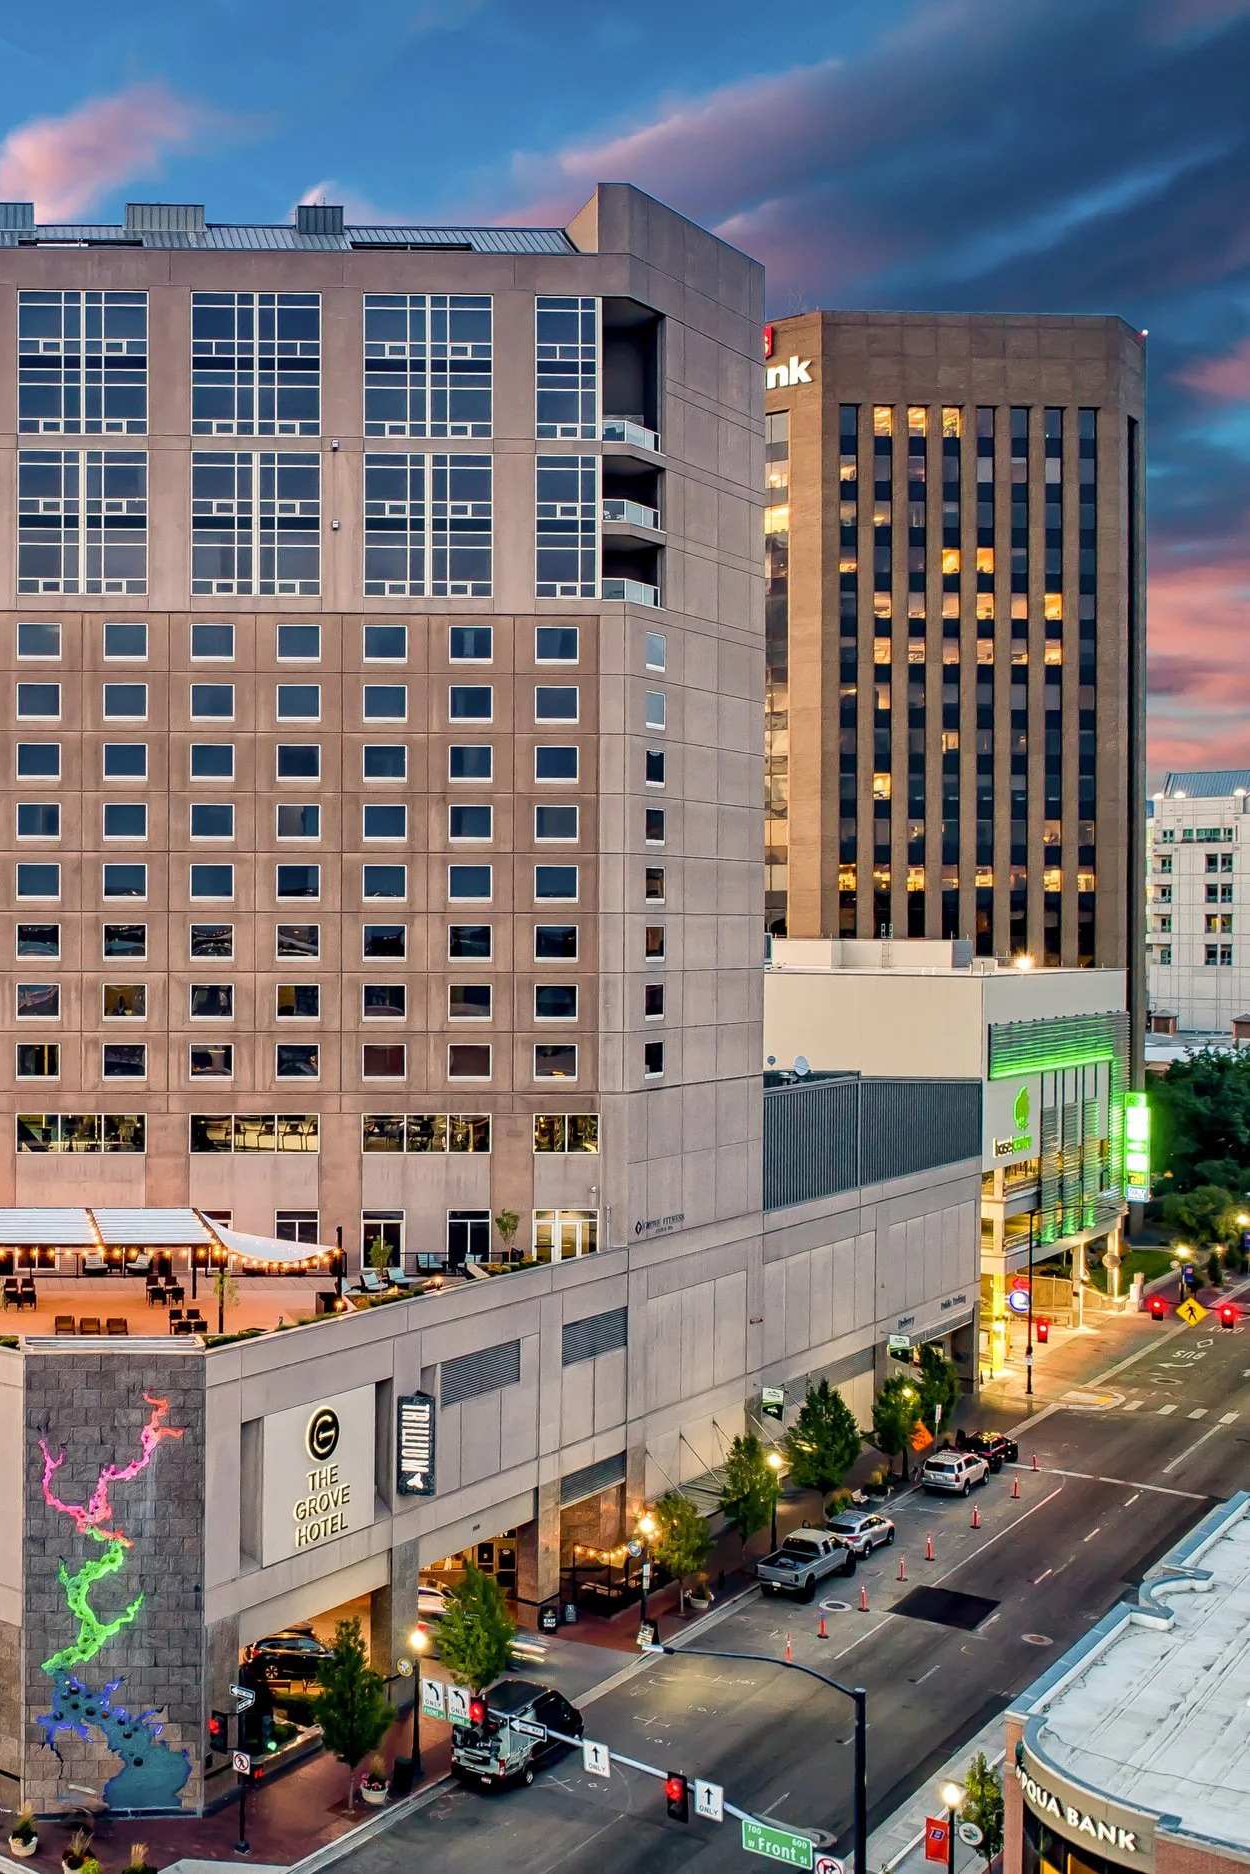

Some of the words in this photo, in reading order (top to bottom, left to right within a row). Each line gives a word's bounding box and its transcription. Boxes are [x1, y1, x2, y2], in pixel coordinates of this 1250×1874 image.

[765, 355, 813, 390] nk
[1171, 1350, 1207, 1360] BUS
[401, 1404, 430, 1473] TRILLIUM
[306, 1464, 339, 1492] THE
[293, 1484, 351, 1522] GROVE
[295, 1512, 349, 1547] HOTEL
[424, 1699, 442, 1708] ONLY
[423, 1707, 439, 1717] FRONT
[450, 1706, 468, 1716] ONLY
[449, 1715, 465, 1725] FRONT
[519, 1723, 530, 1732] ONE
[532, 1726, 542, 1734] WAY
[588, 1762, 606, 1773] ONLY
[699, 1805, 719, 1816] ONLY
[747, 1824, 762, 1835] 700
[1067, 1806, 1136, 1852] BANK
[758, 1837, 797, 1861] Front
[792, 1838, 807, 1849] 600
